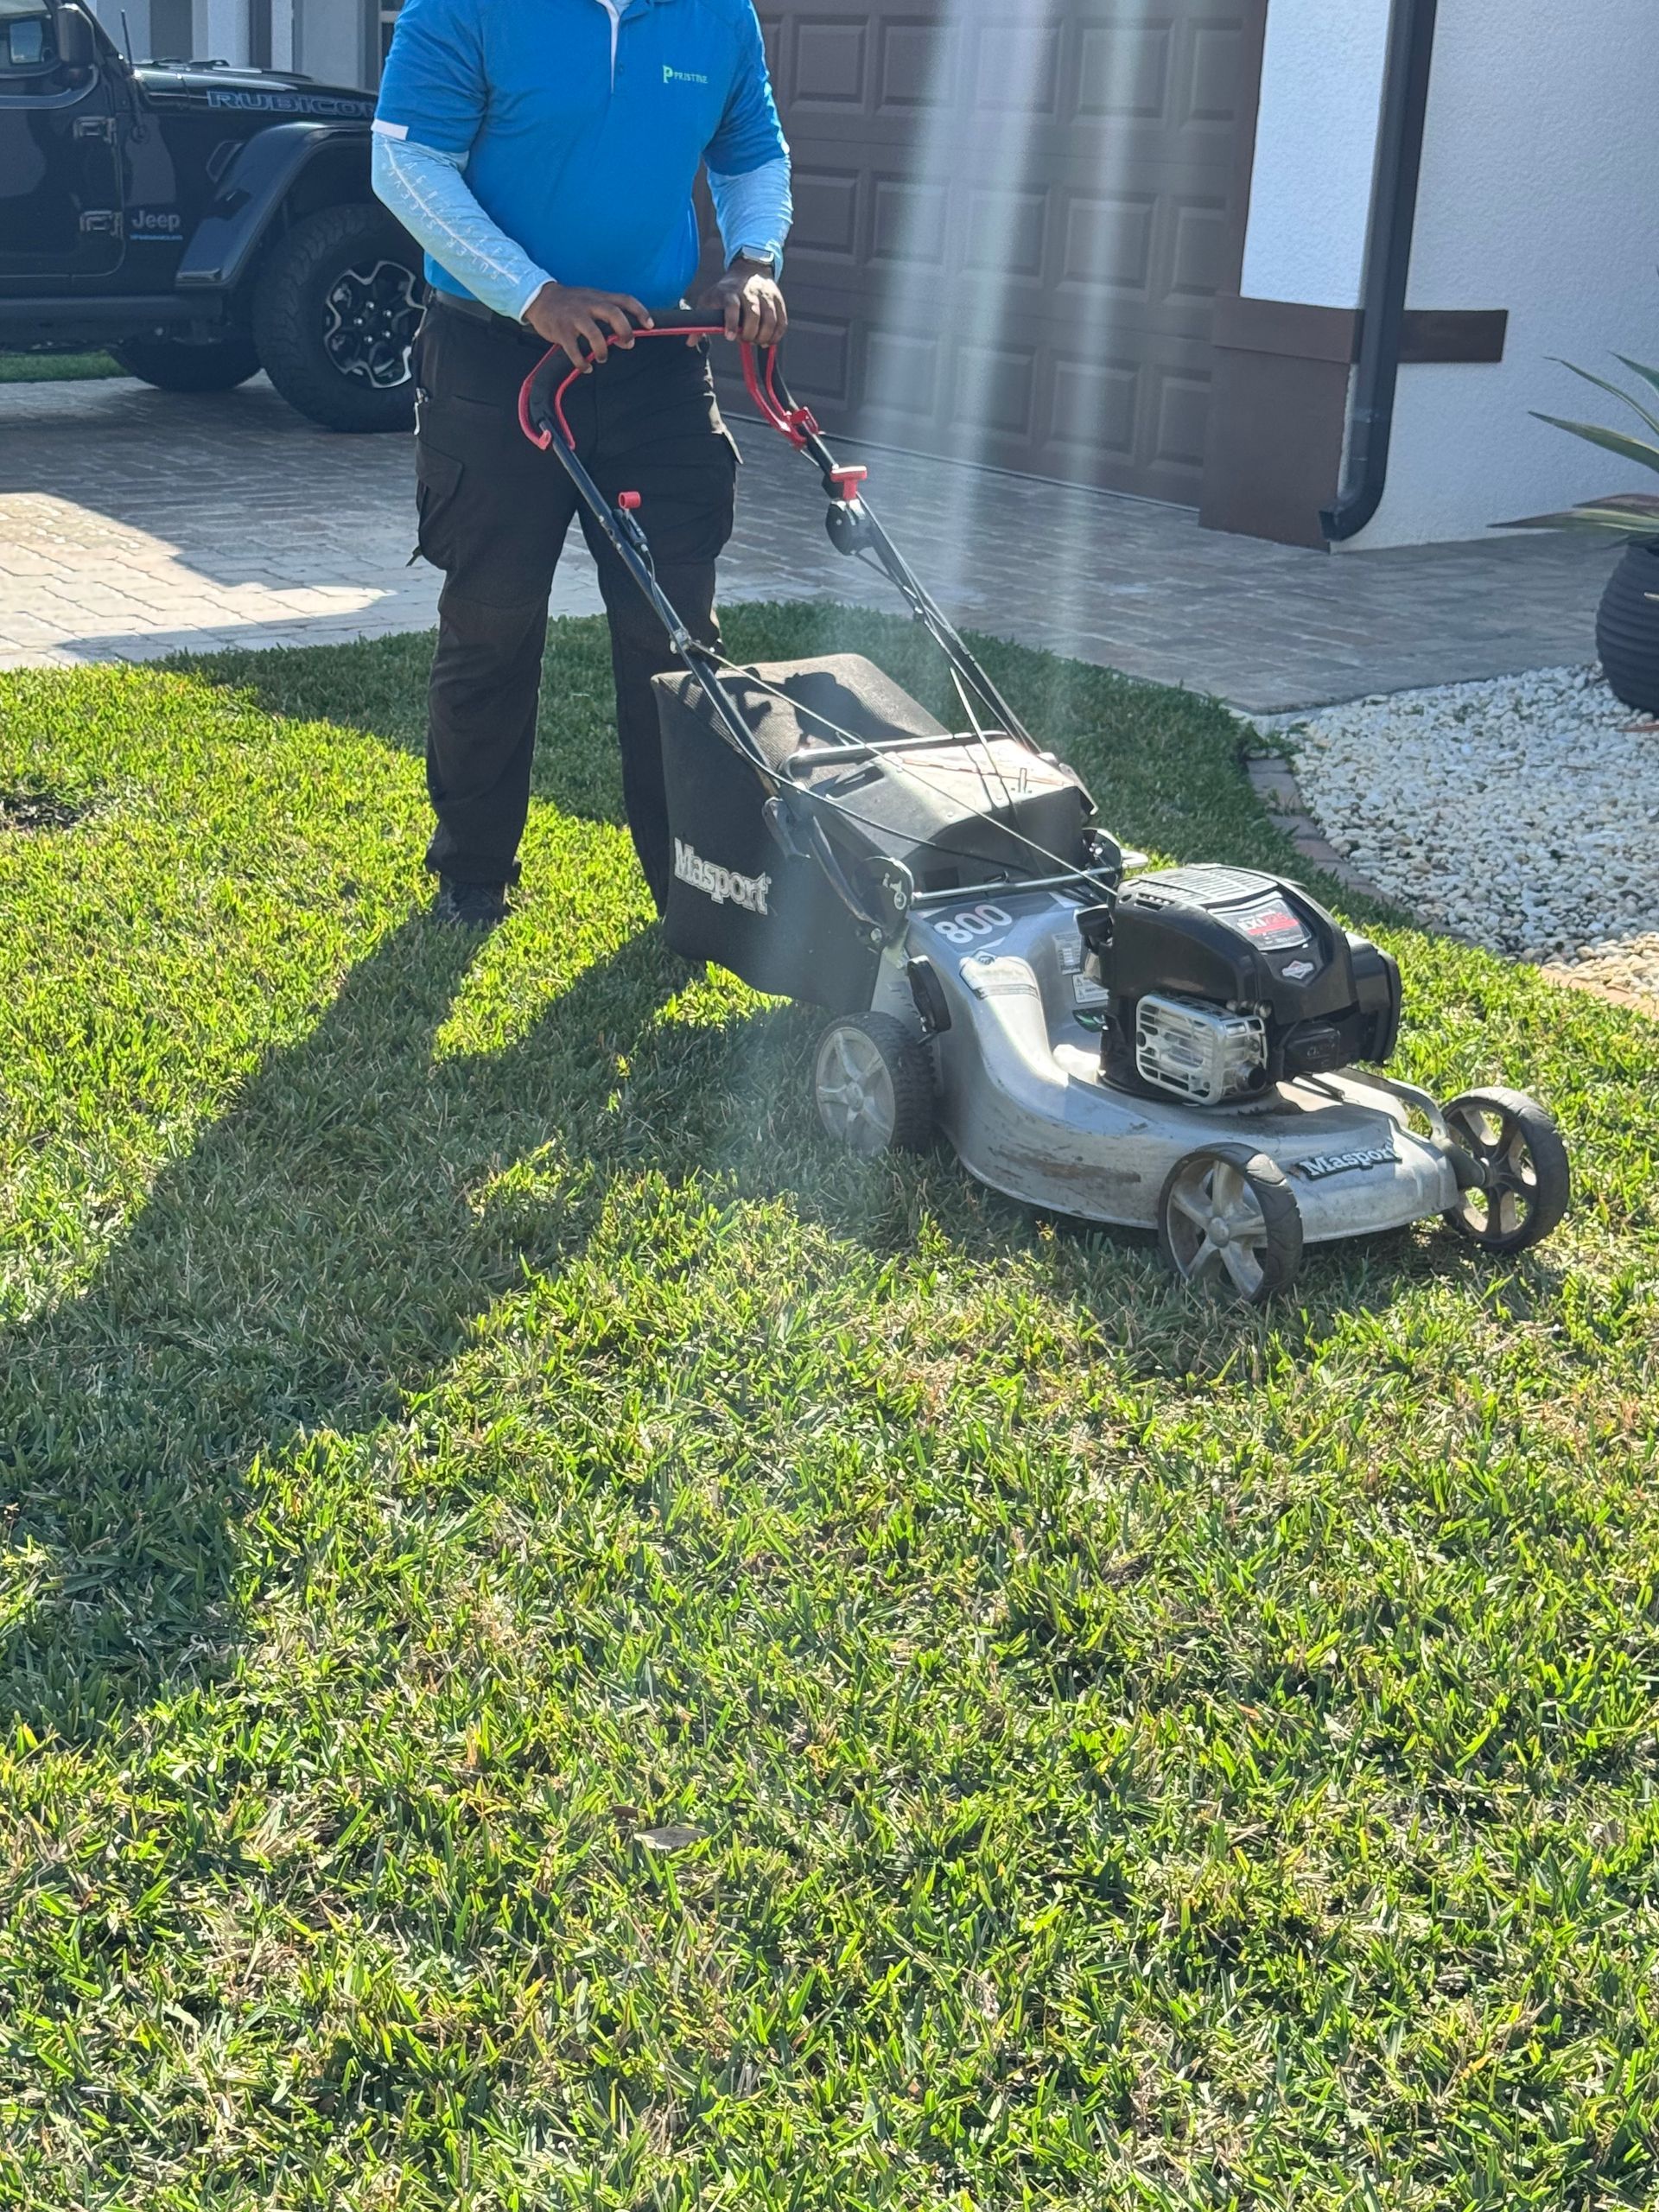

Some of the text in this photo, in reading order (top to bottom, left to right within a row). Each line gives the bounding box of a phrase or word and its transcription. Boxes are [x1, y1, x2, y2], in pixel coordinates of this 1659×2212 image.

[673, 72, 709, 84] PRISTINE
[131, 210, 181, 232] Jeep
[674, 836, 768, 916] Masport
[934, 904, 1013, 944] 800
[1299, 1141, 1400, 1177] Masport
